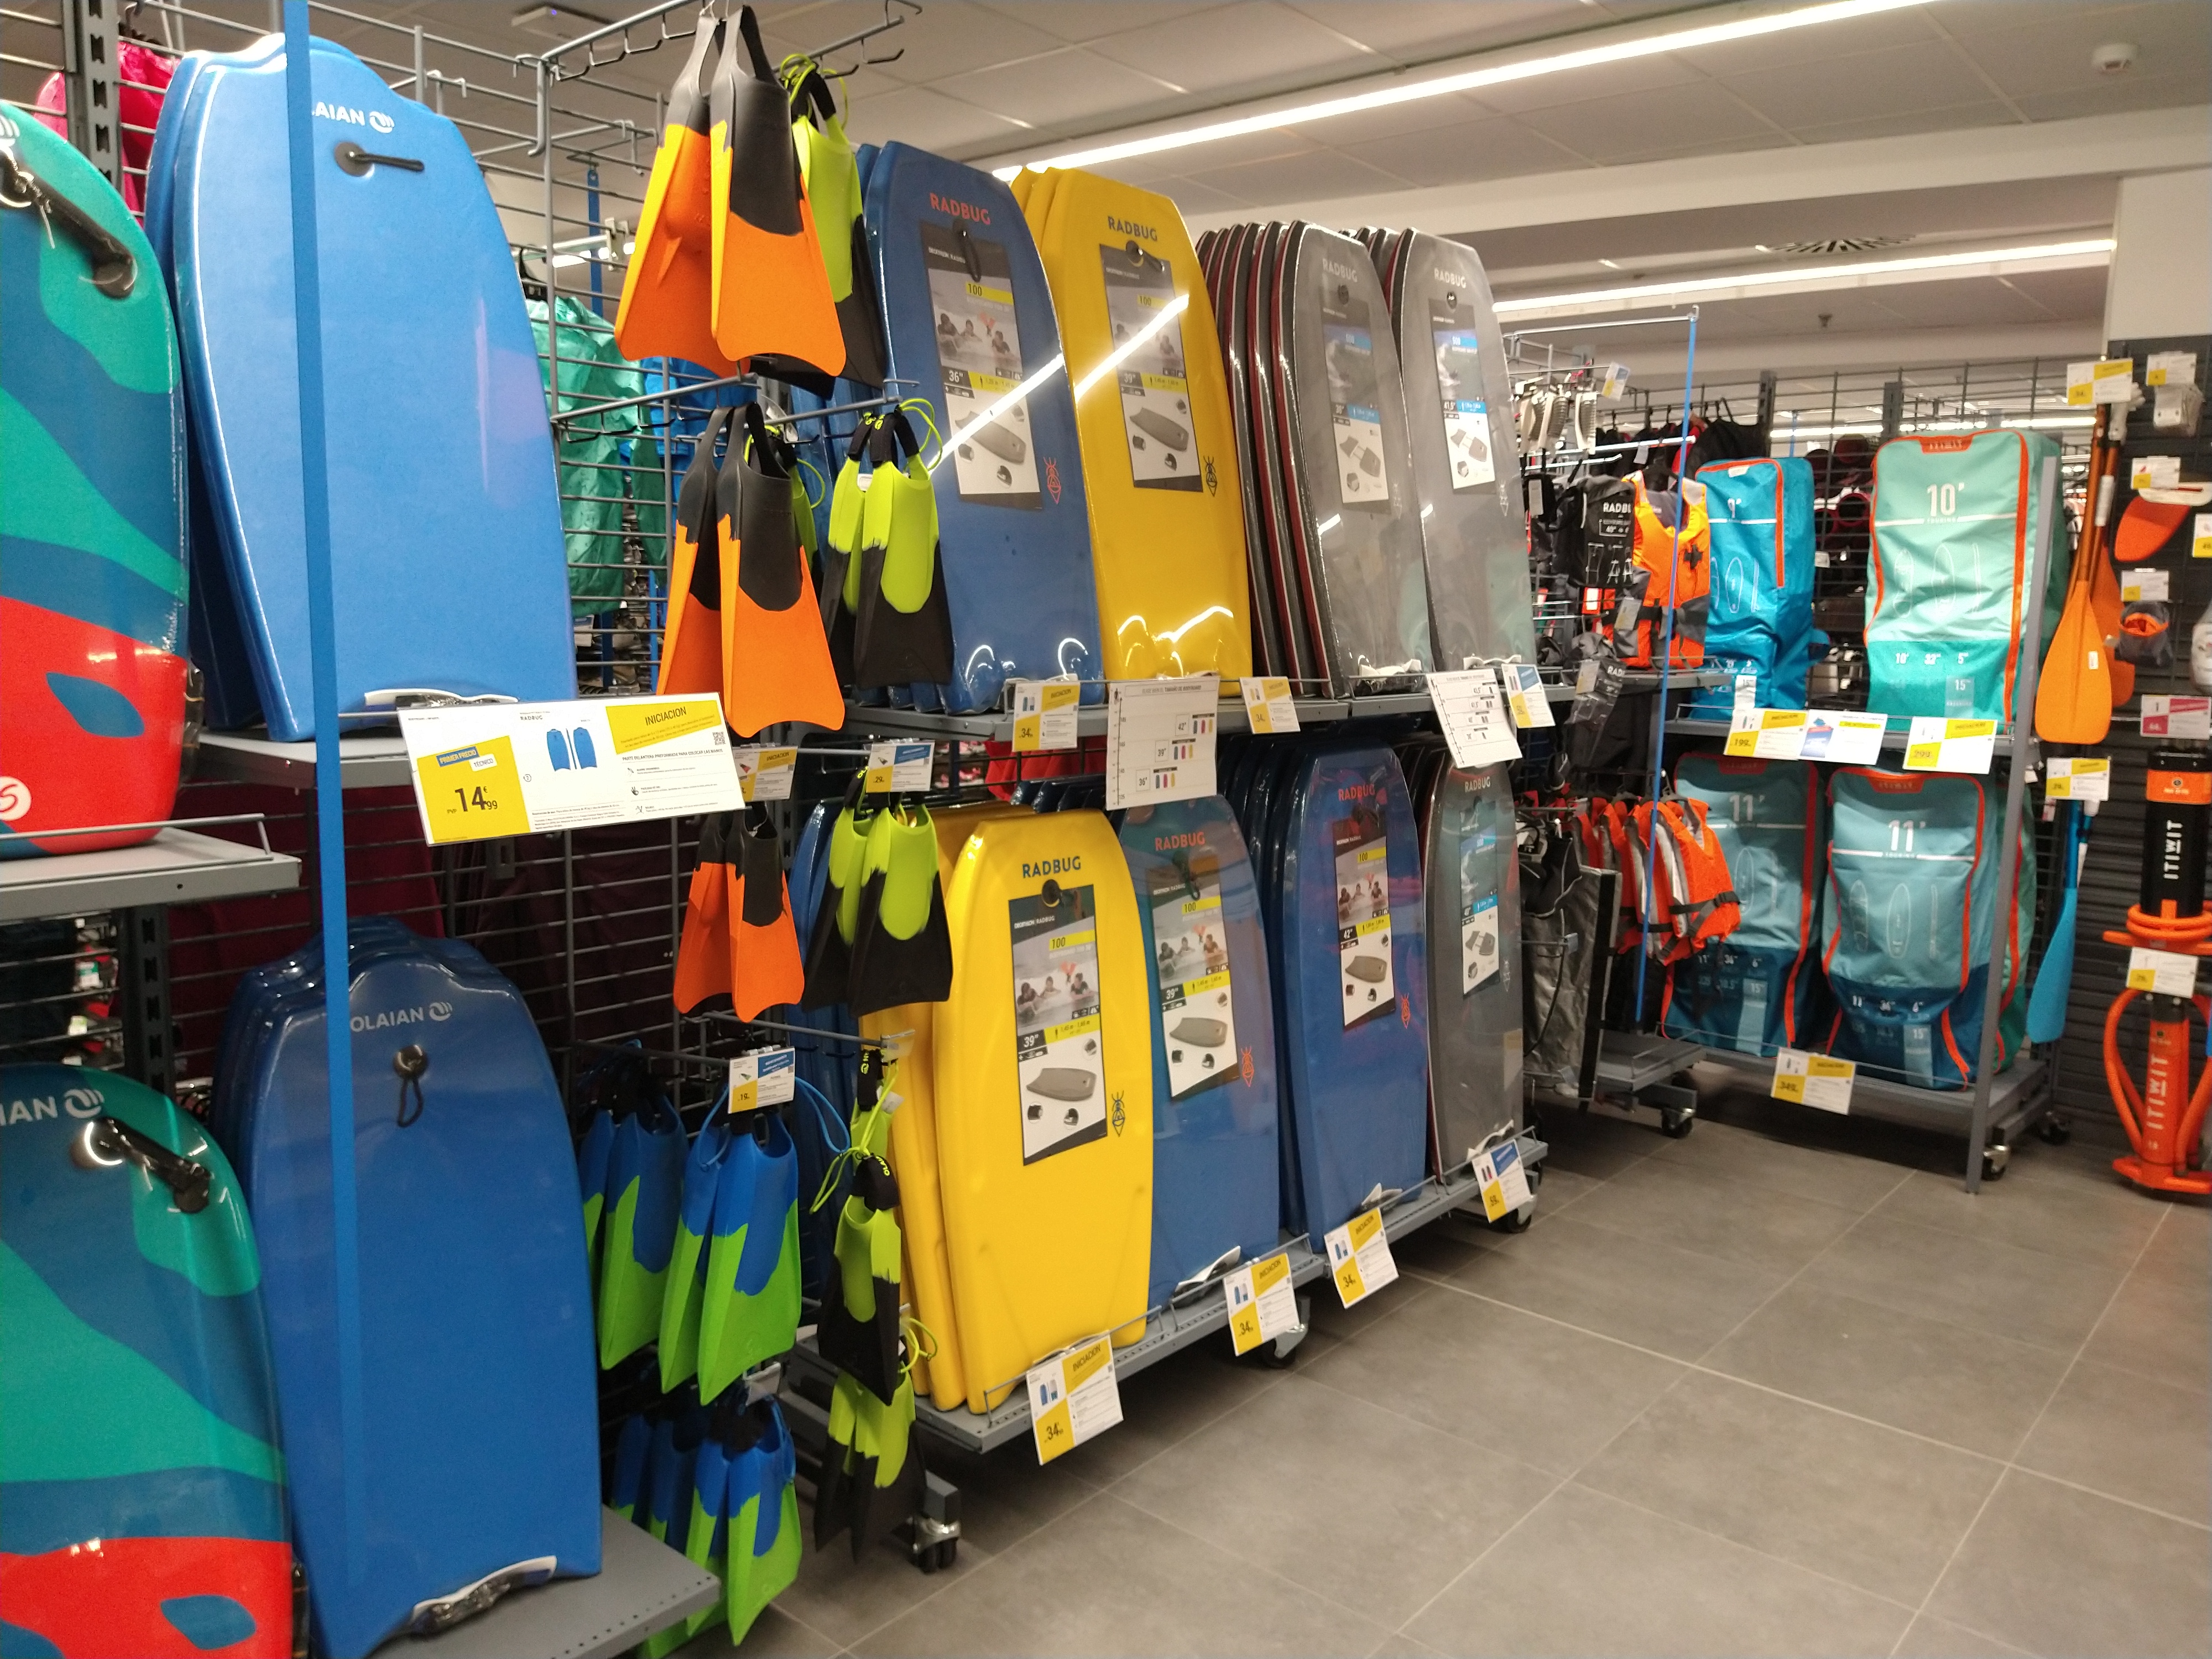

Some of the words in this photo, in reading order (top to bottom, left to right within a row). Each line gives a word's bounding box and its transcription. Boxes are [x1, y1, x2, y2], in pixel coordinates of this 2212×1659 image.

[312, 102, 366, 126] AIAN
[930, 192, 992, 225] RADBUG
[1108, 216, 1158, 242] RADBUG
[1322, 258, 1358, 283] RADBUG
[1434, 267, 1467, 289] RADBUG
[968, 284, 982, 296] 100
[1139, 296, 1152, 306] 100
[645, 706, 687, 726] INICIACION
[1338, 784, 1375, 801] RADBUG
[1465, 776, 1491, 792] RADBUG
[455, 786, 486, 812] 14
[1155, 831, 1206, 852] RADBUG
[2163, 820, 2184, 880] ITIWIT
[1022, 856, 1081, 879] RADBUG
[1359, 852, 1368, 862] 100
[1184, 902, 1197, 913] 100
[1052, 937, 1066, 949] 100
[350, 1006, 424, 1032] OLAIAN
[1024, 1034, 1039, 1048] 39"
